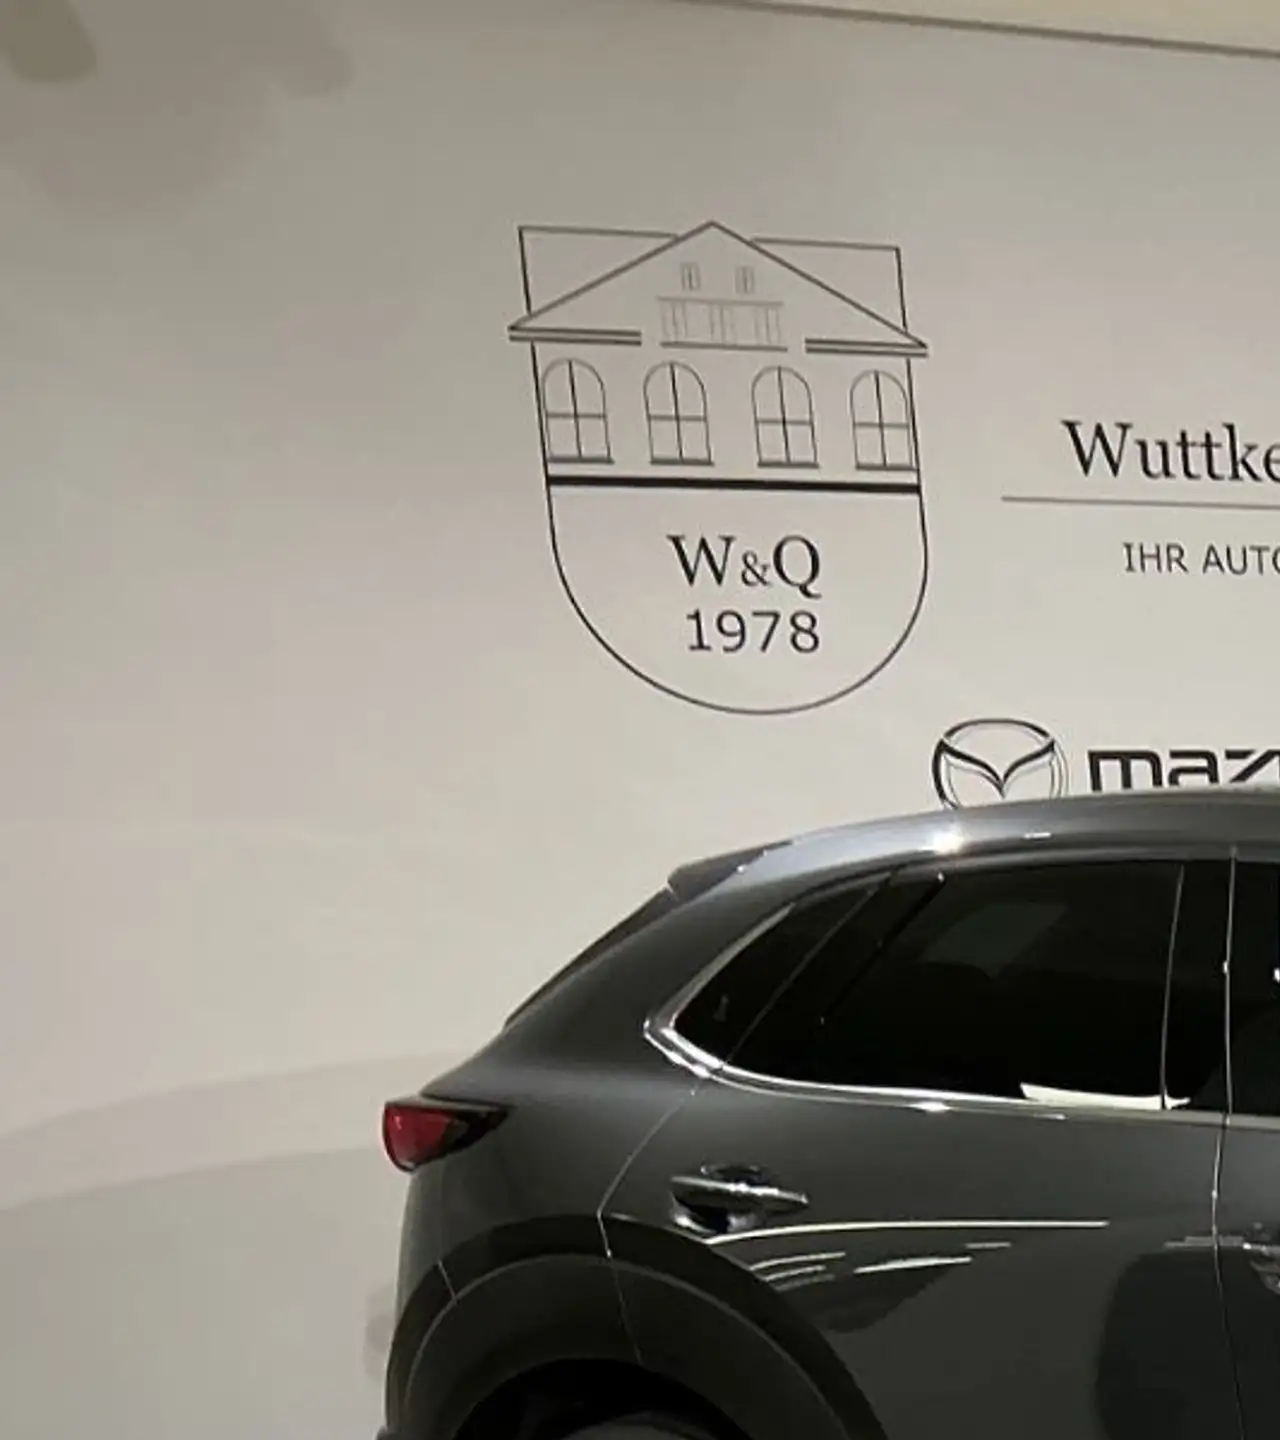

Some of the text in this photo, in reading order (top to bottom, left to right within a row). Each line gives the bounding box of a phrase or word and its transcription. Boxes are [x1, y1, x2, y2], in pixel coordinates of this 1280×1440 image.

[665, 533, 822, 600] W&Q
[1122, 541, 1189, 575] IHR
[685, 607, 820, 654] 1978
